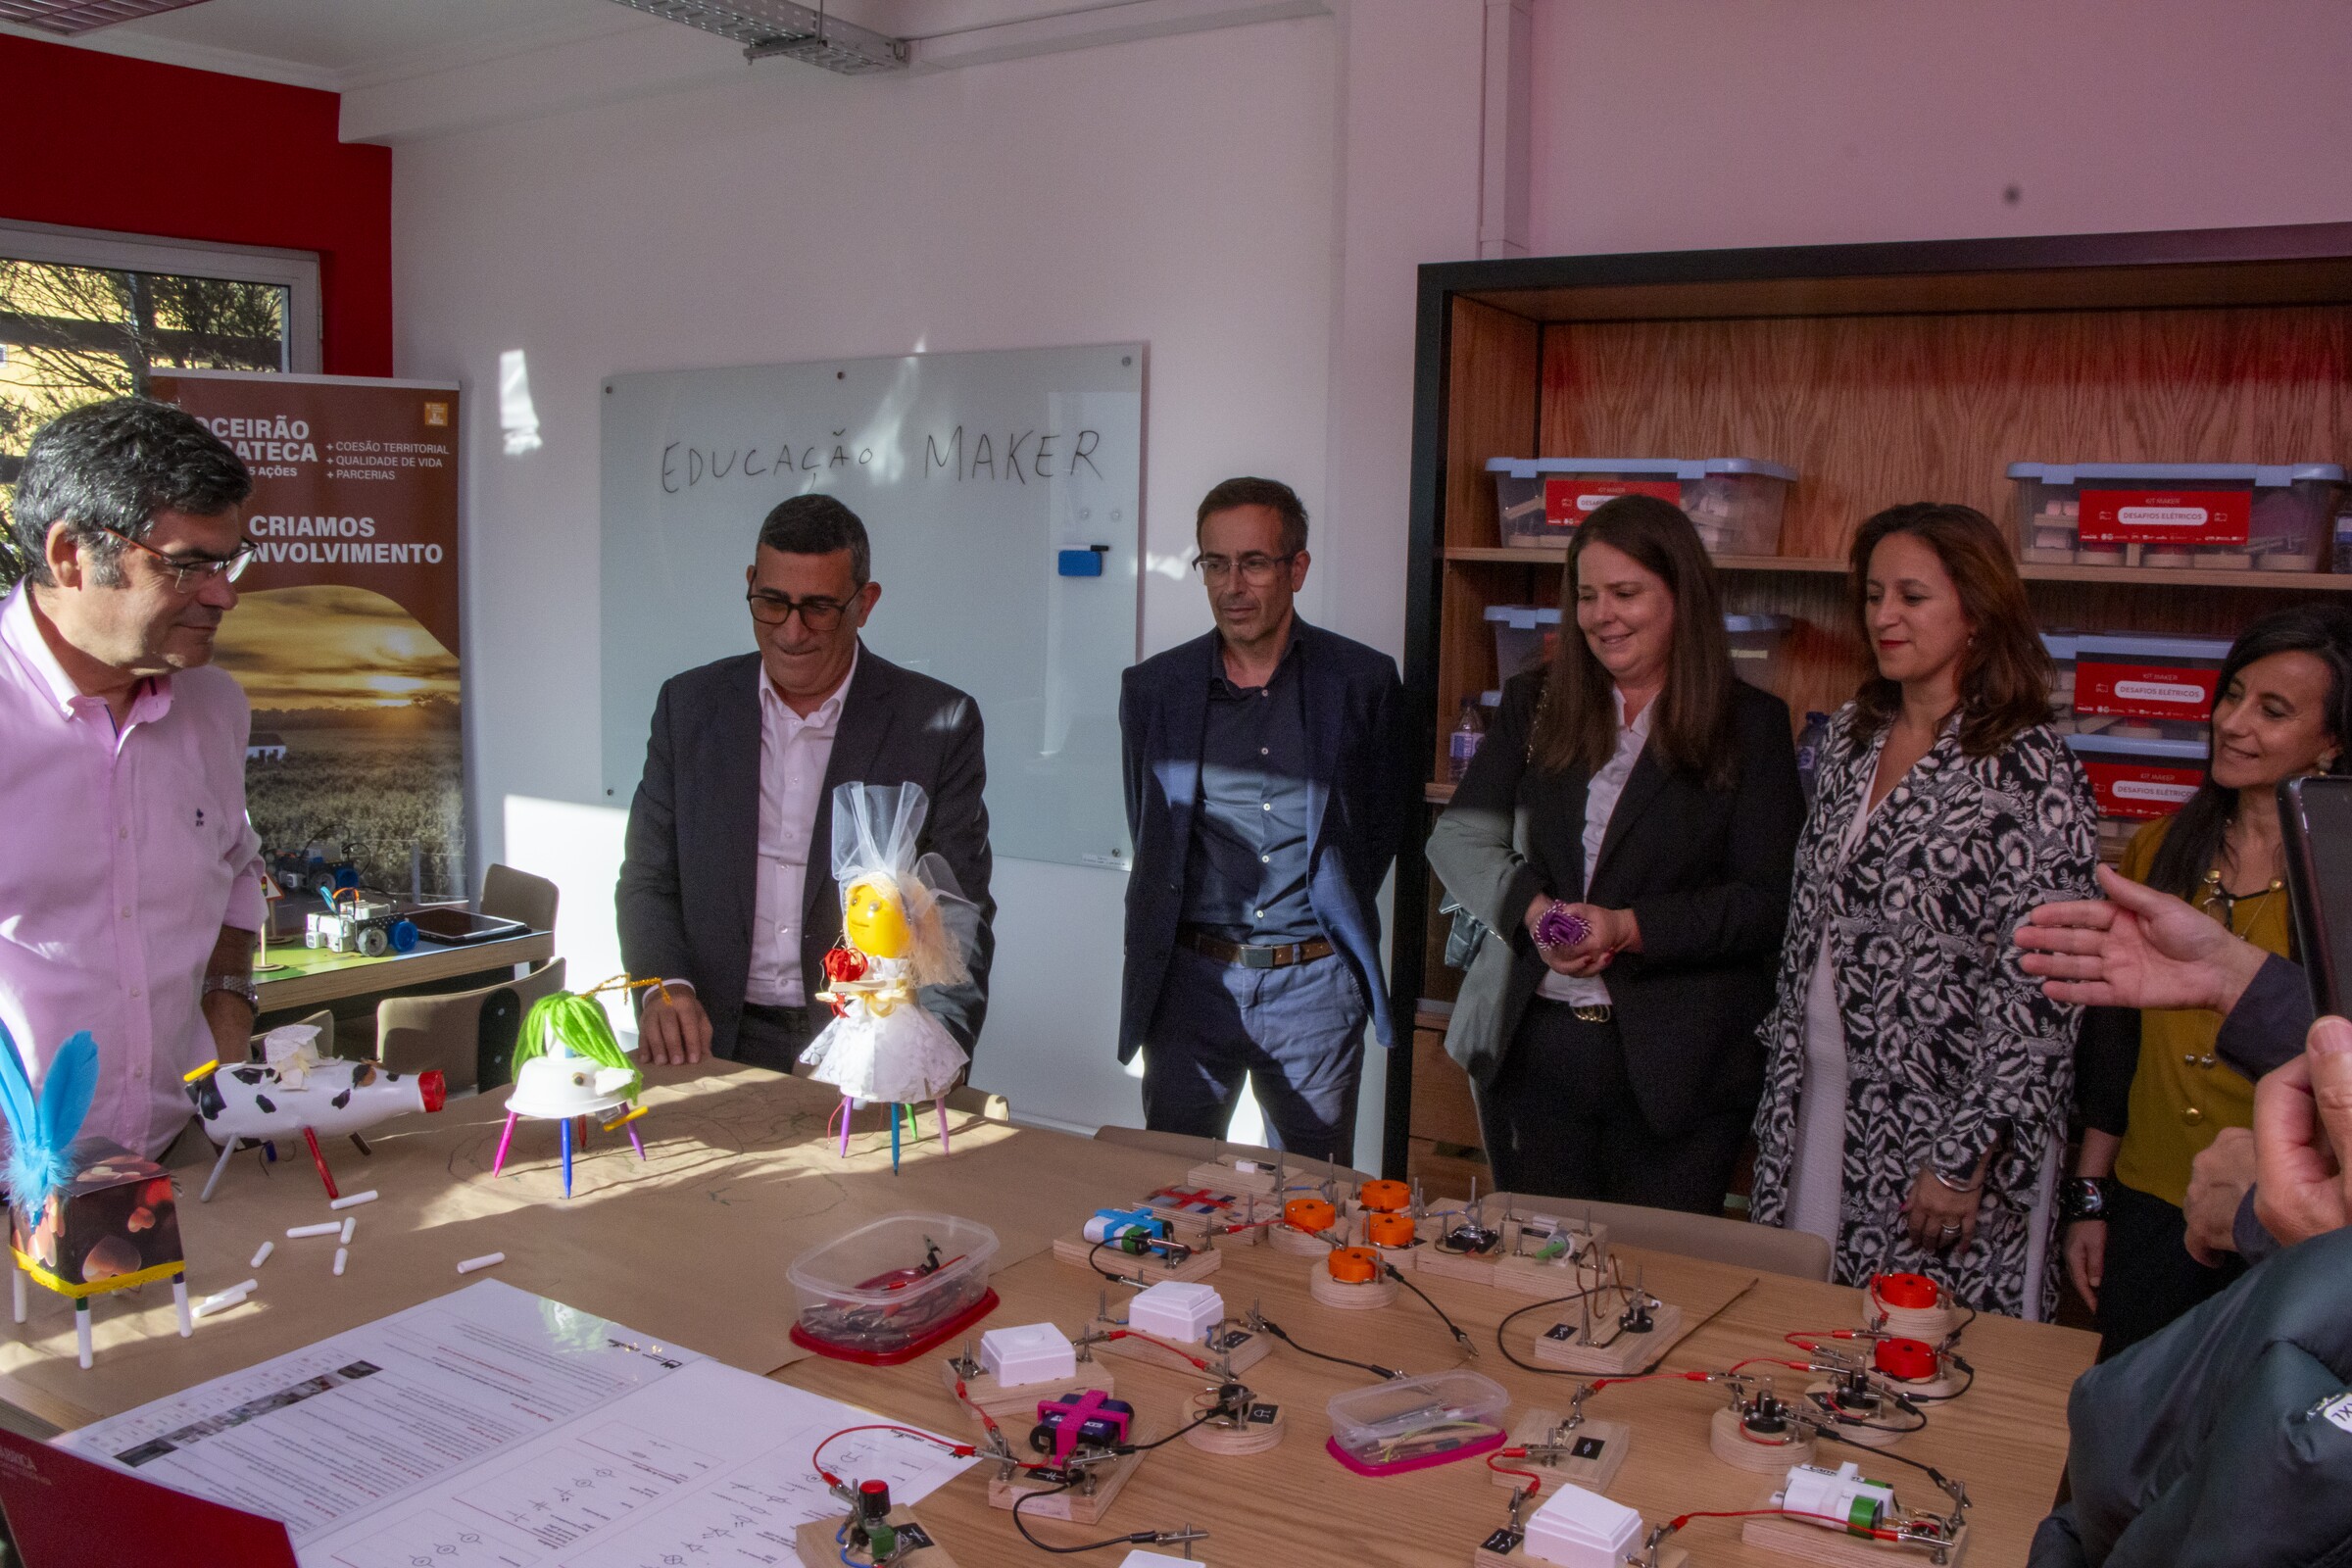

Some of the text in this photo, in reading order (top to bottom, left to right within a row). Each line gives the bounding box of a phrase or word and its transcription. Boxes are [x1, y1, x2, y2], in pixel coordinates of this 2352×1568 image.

[336, 441, 380, 452] COESÃO
[383, 443, 450, 455] TERRITORIAL
[336, 456, 399, 466] QUALIDADE
[402, 458, 416, 467] DE
[418, 459, 443, 467] VIDA
[661, 425, 1103, 494] EDUCAÇÃO MAKER
[258, 465, 298, 478] AÇÕES
[336, 469, 396, 480] PARCERIAS
[2161, 512, 2203, 520] ELÉTRICOS
[249, 515, 376, 537] CRIAMOS
[2120, 686, 2199, 698] DESAFIOS ELÉTRICOS
[2117, 786, 2194, 798] DESAFIOS ELÉTRICO
